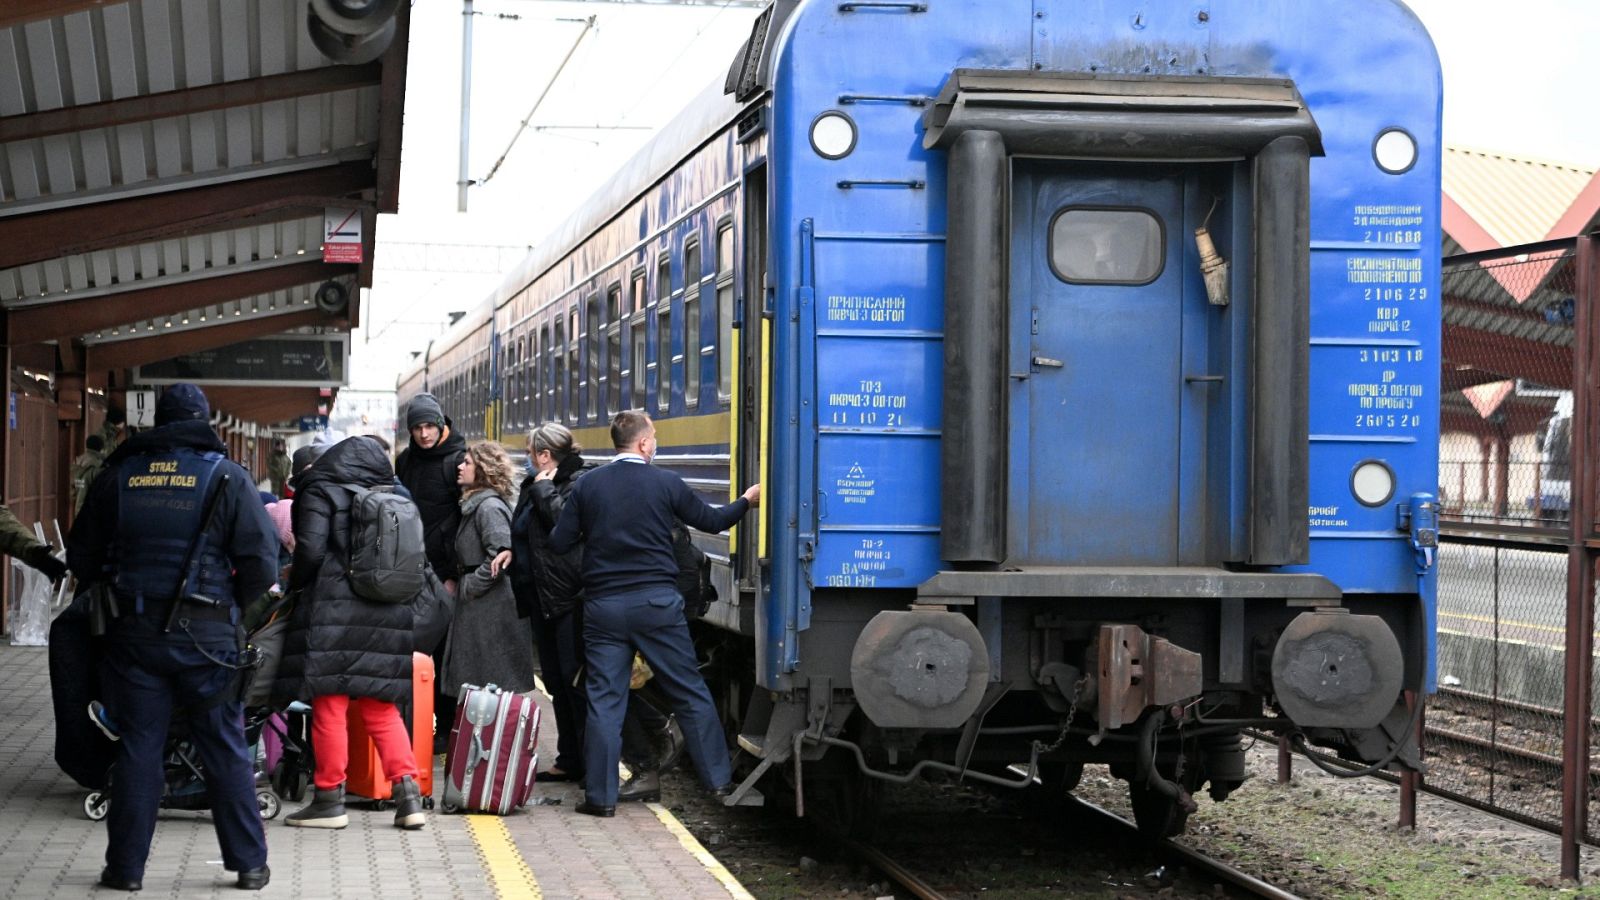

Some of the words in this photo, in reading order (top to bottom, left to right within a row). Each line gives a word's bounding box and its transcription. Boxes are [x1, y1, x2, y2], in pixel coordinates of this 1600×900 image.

[149, 461, 178, 473] STRAŻ
[128, 476, 168, 488] OCHRONY
[169, 476, 197, 488] KOLEI
